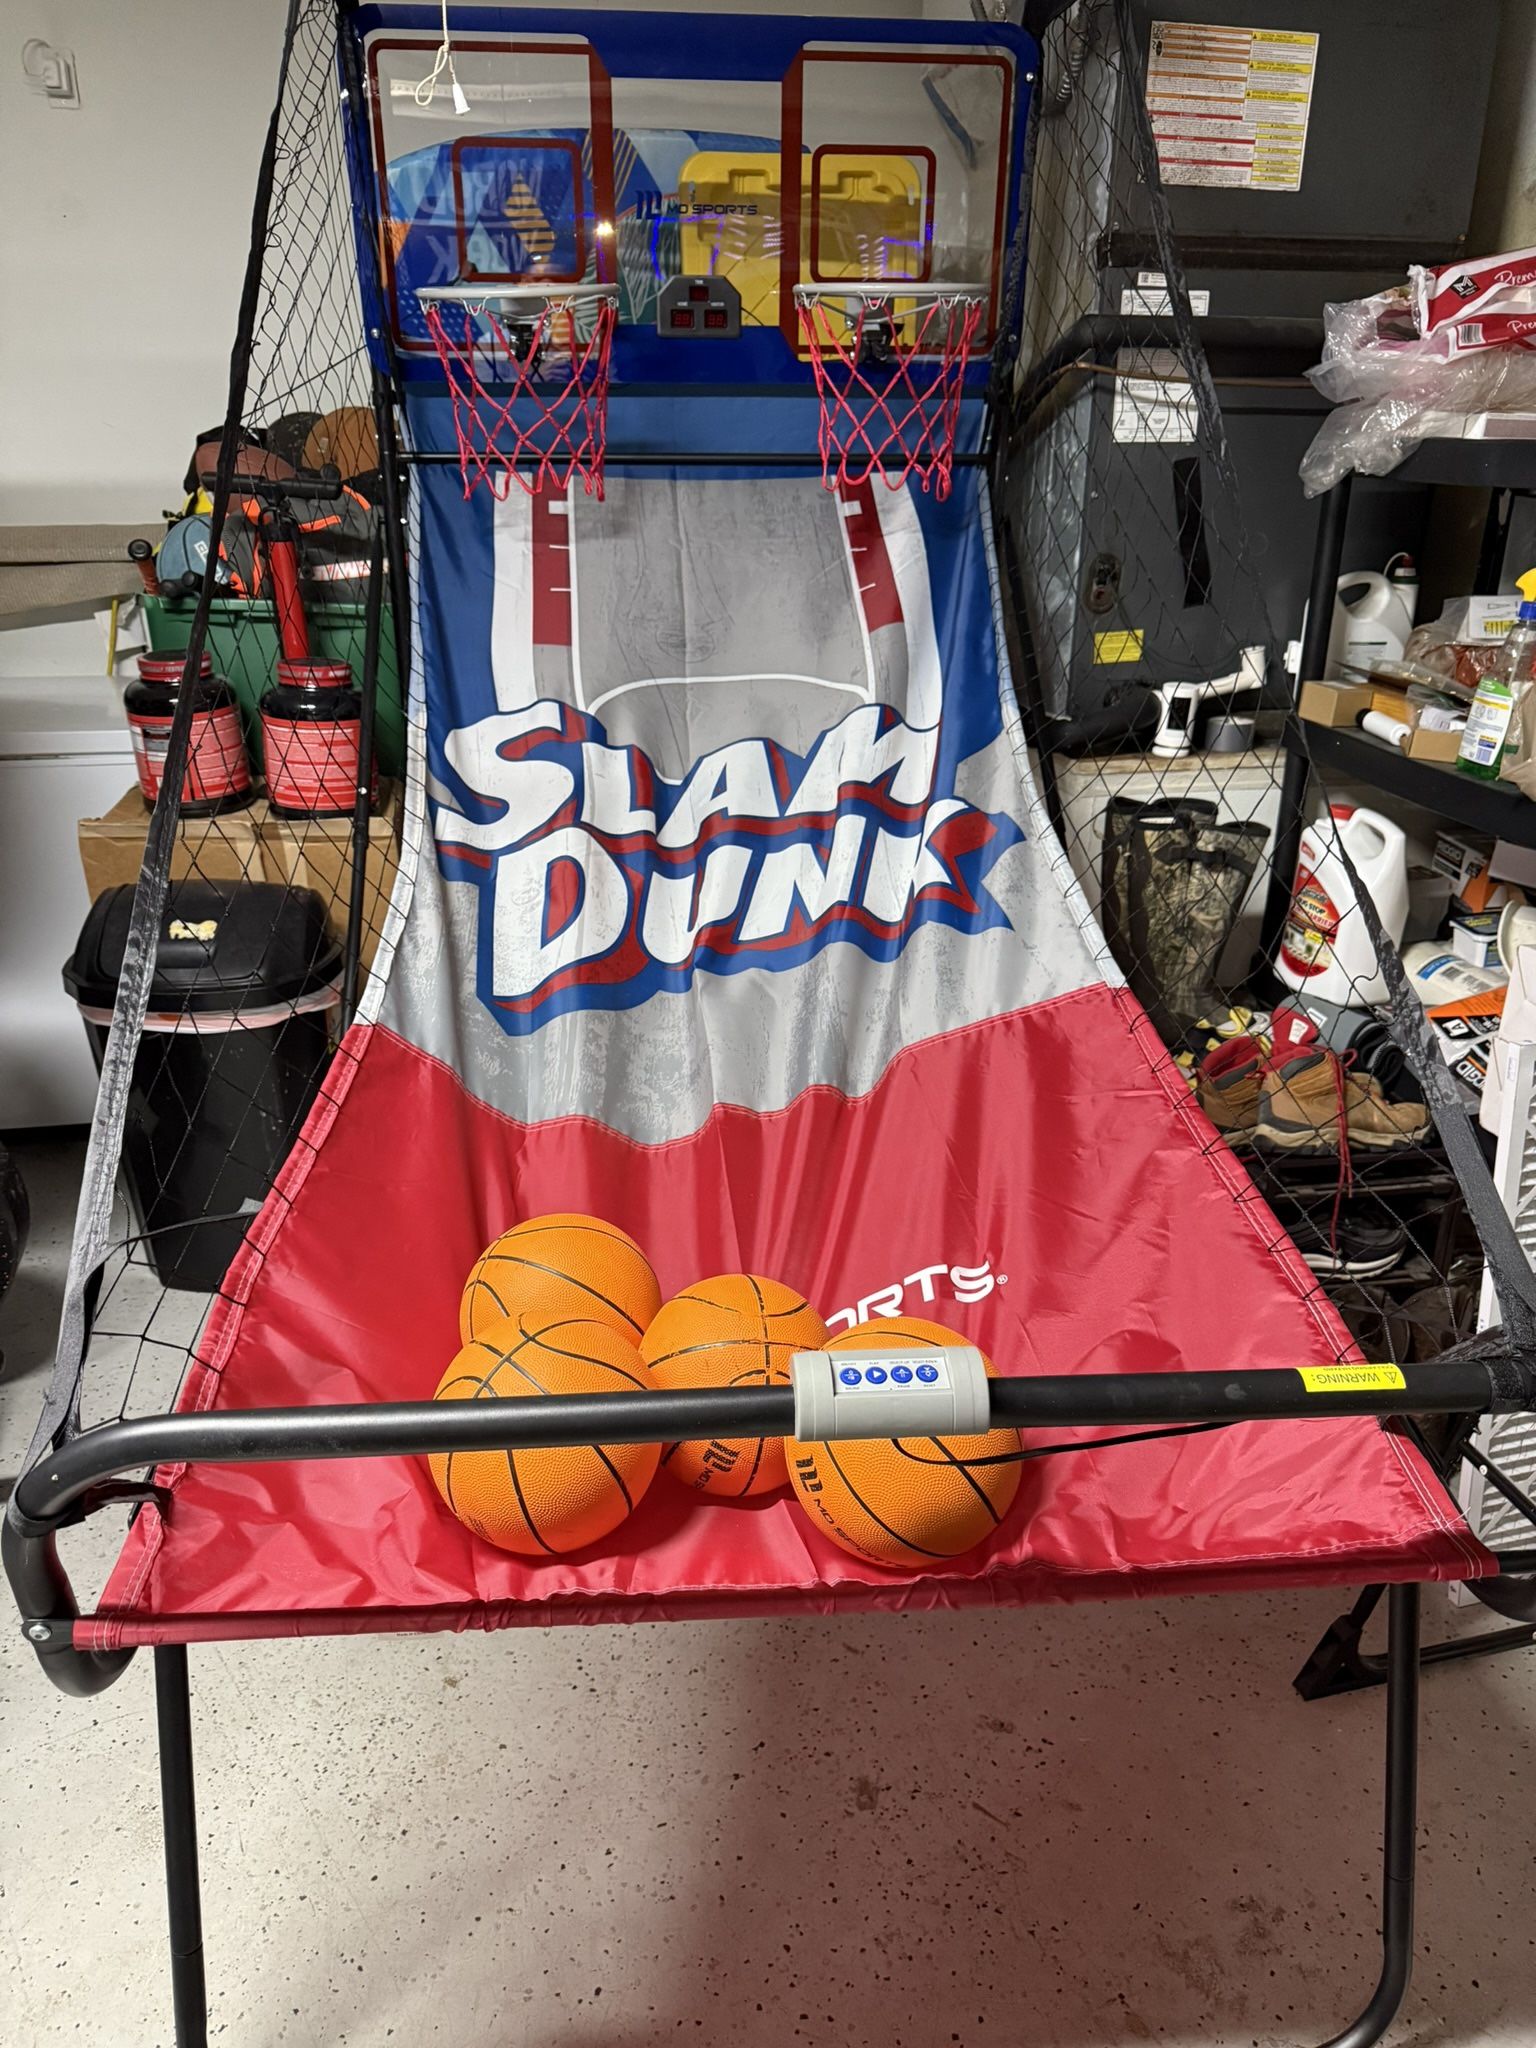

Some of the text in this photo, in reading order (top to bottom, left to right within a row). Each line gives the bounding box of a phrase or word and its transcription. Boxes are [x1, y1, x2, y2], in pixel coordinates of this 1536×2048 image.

[692, 204, 758, 215] SPORTS
[433, 700, 942, 852] SLAM
[490, 797, 971, 998] DUNK
[1308, 903, 1327, 915] STOP
